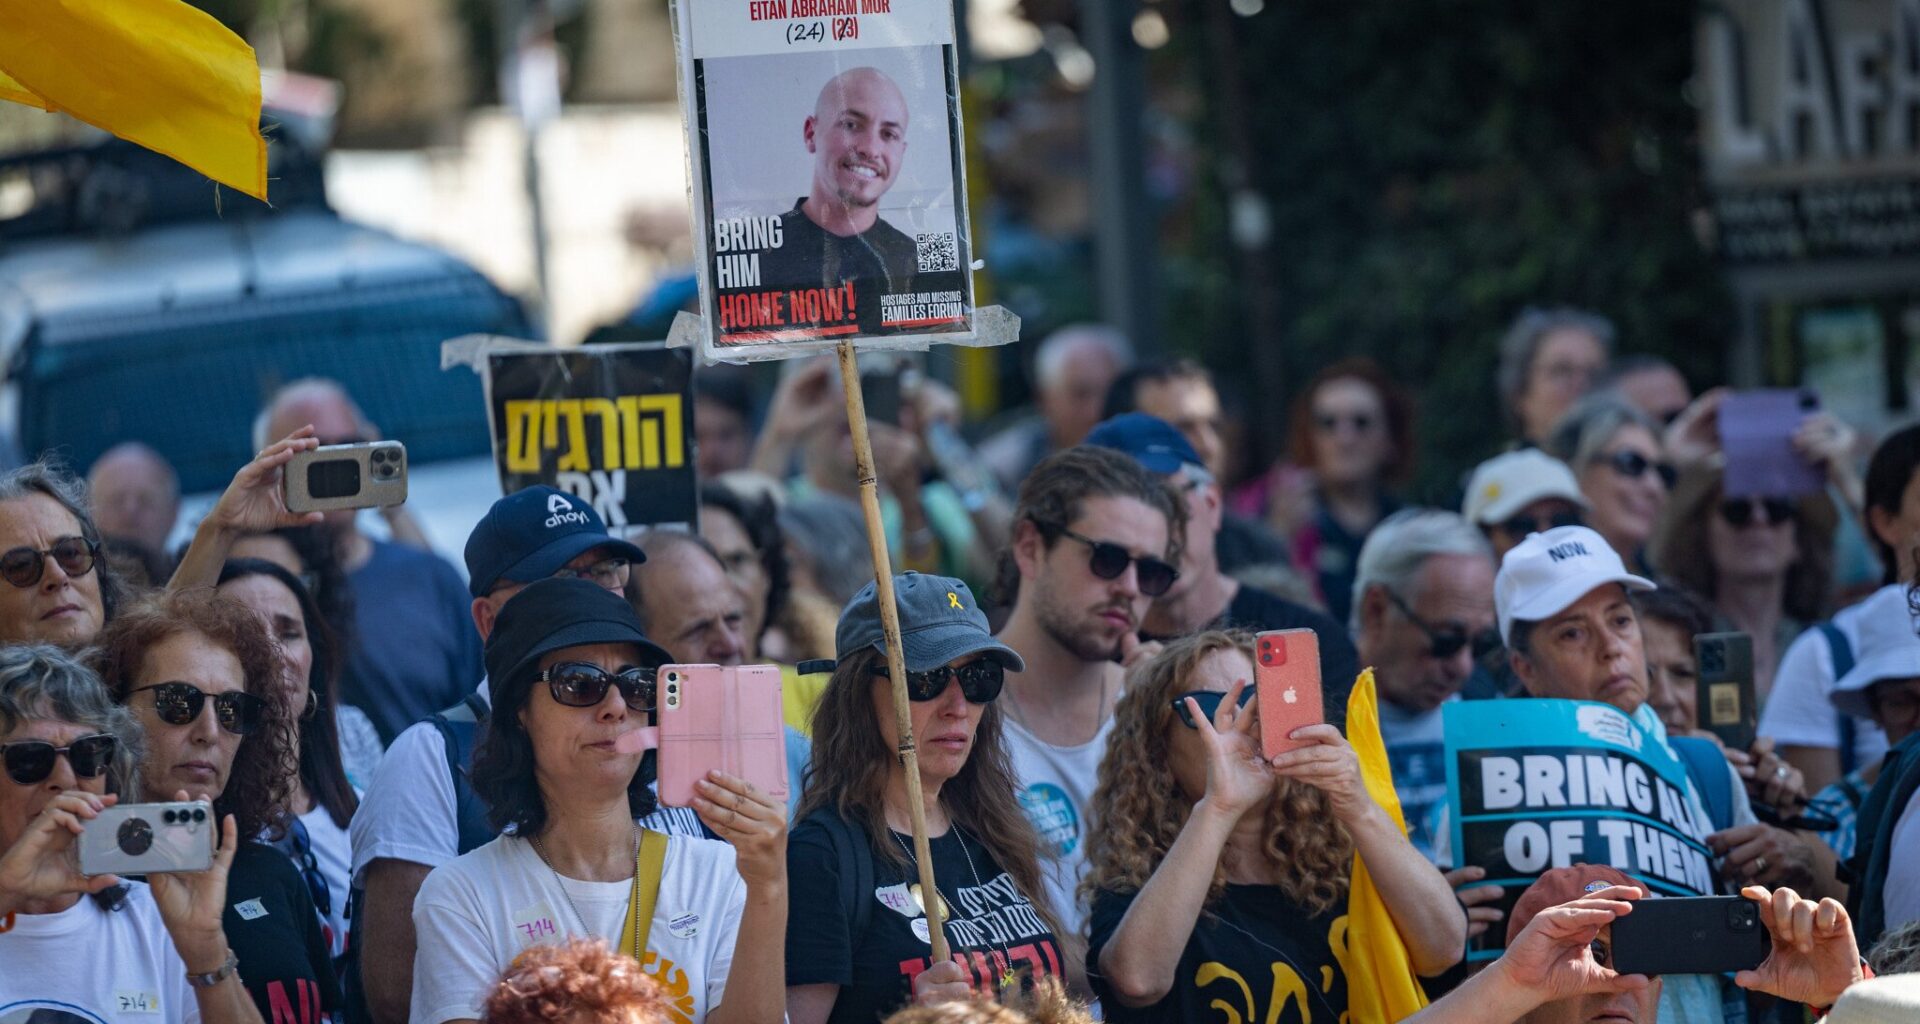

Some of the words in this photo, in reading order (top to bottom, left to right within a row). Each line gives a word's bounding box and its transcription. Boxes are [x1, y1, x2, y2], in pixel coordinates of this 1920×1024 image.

[749, 0, 788, 21] EITAN
[791, 0, 858, 18] ABRAHAM
[861, 0, 891, 14] MOR
[786, 21, 825, 44] (24)
[714, 215, 784, 252] BRING
[716, 253, 761, 289] HIM
[719, 291, 785, 329] HOME
[790, 280, 857, 325] NOW!
[880, 293, 916, 306] HOSTAGES
[916, 292, 931, 304] AND
[931, 290, 962, 303] MISSING
[881, 304, 926, 322] FAMILIES
[927, 302, 963, 320] FORUM
[505, 393, 684, 474] הורגים
[1481, 755, 1653, 814] BRING
[1504, 820, 1584, 874] OF
[1597, 819, 1714, 897] THEM
[880, 892, 909, 908] 714
[517, 918, 556, 942] 714
[119, 992, 147, 1010] 714
